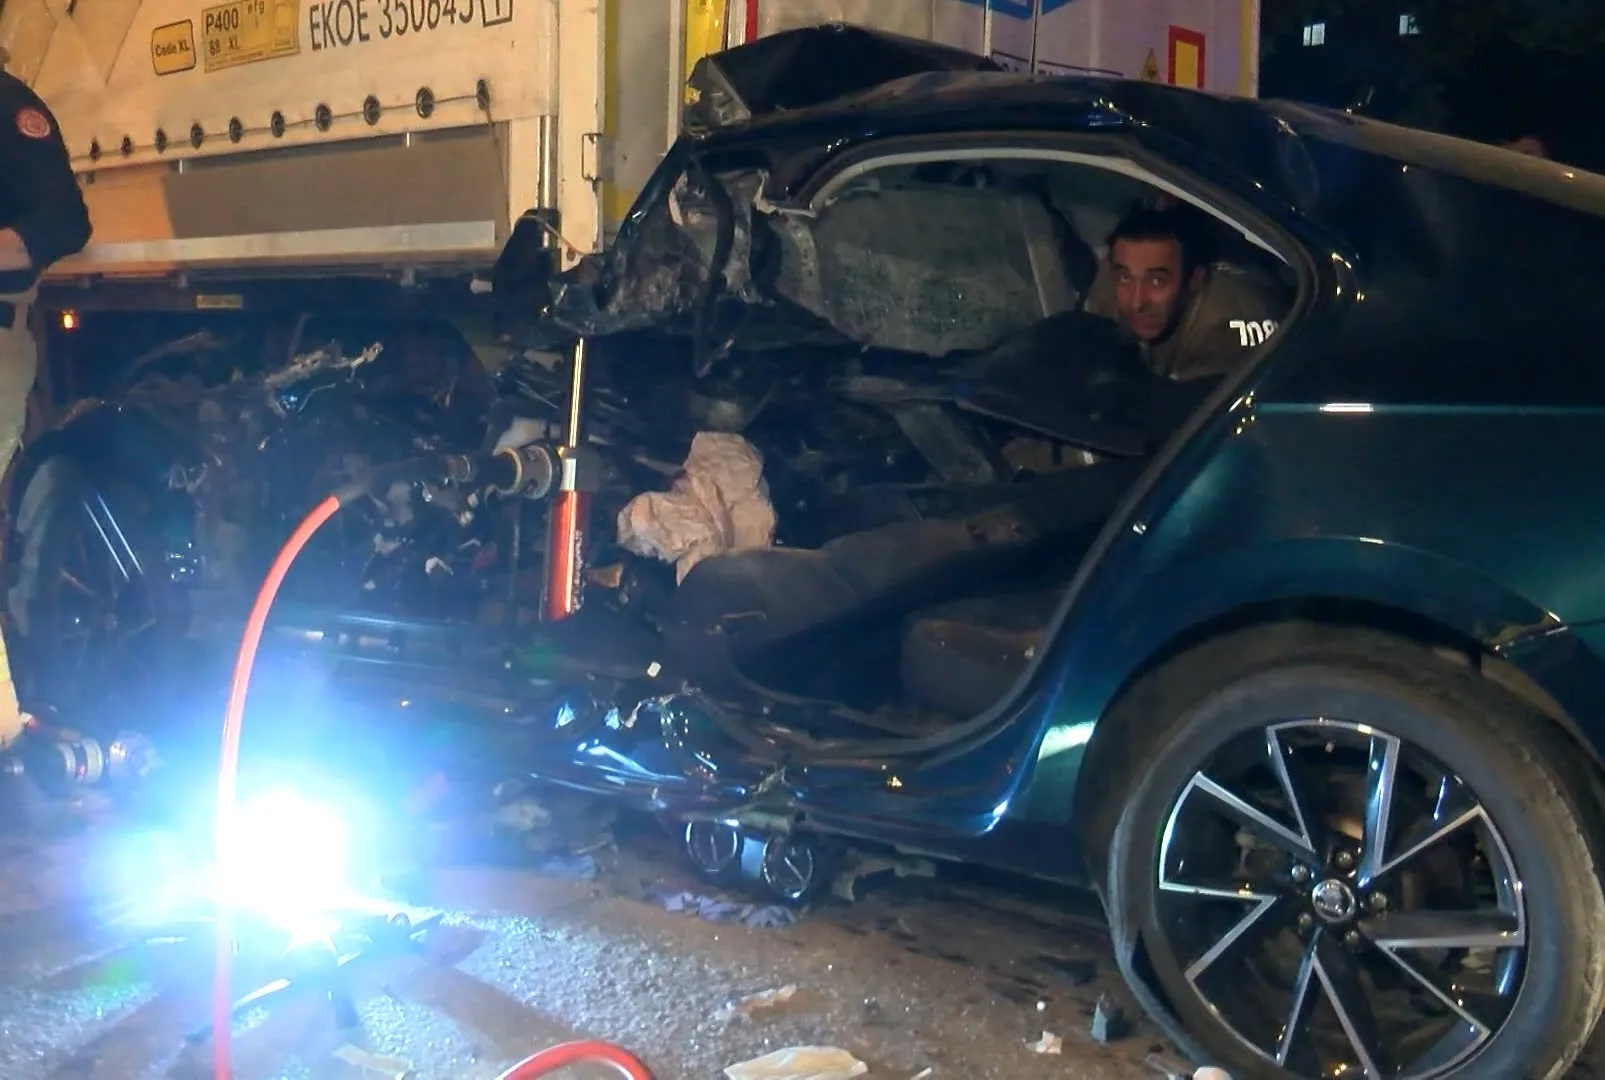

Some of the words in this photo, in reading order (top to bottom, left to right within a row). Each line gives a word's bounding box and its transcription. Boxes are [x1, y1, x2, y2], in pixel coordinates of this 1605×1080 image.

[309, 0, 370, 50] EKOE
[155, 42, 177, 57] Code
[178, 39, 190, 52] XL
